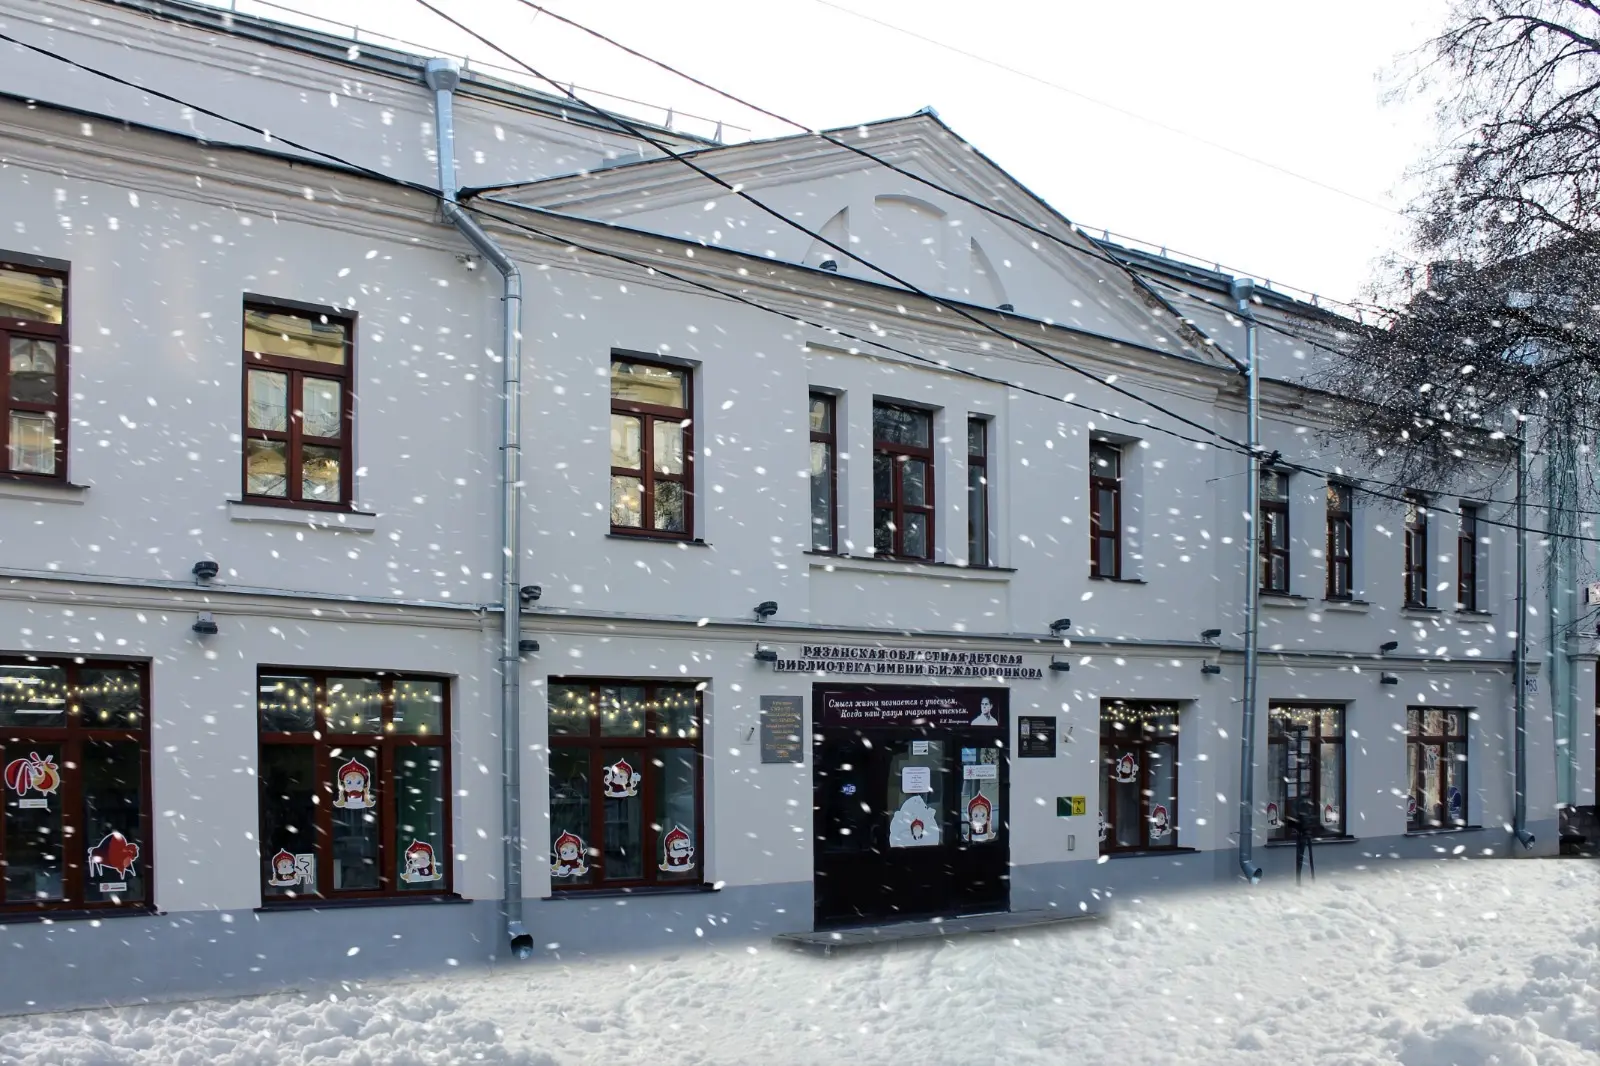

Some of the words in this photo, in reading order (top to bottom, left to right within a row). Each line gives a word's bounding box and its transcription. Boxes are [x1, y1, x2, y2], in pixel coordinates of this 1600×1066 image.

[803, 645, 885, 660] РЯЗАНСКАЯ
[968, 653, 1023, 665] ДЕТСКАЯ
[776, 659, 872, 673] БИБЛИОТЕКА
[876, 663, 923, 675] ИМЕНИ
[828, 699, 853, 708] Смысл
[840, 709, 862, 718] Когда
[881, 710, 903, 719] разум
[904, 709, 936, 718] очарован
